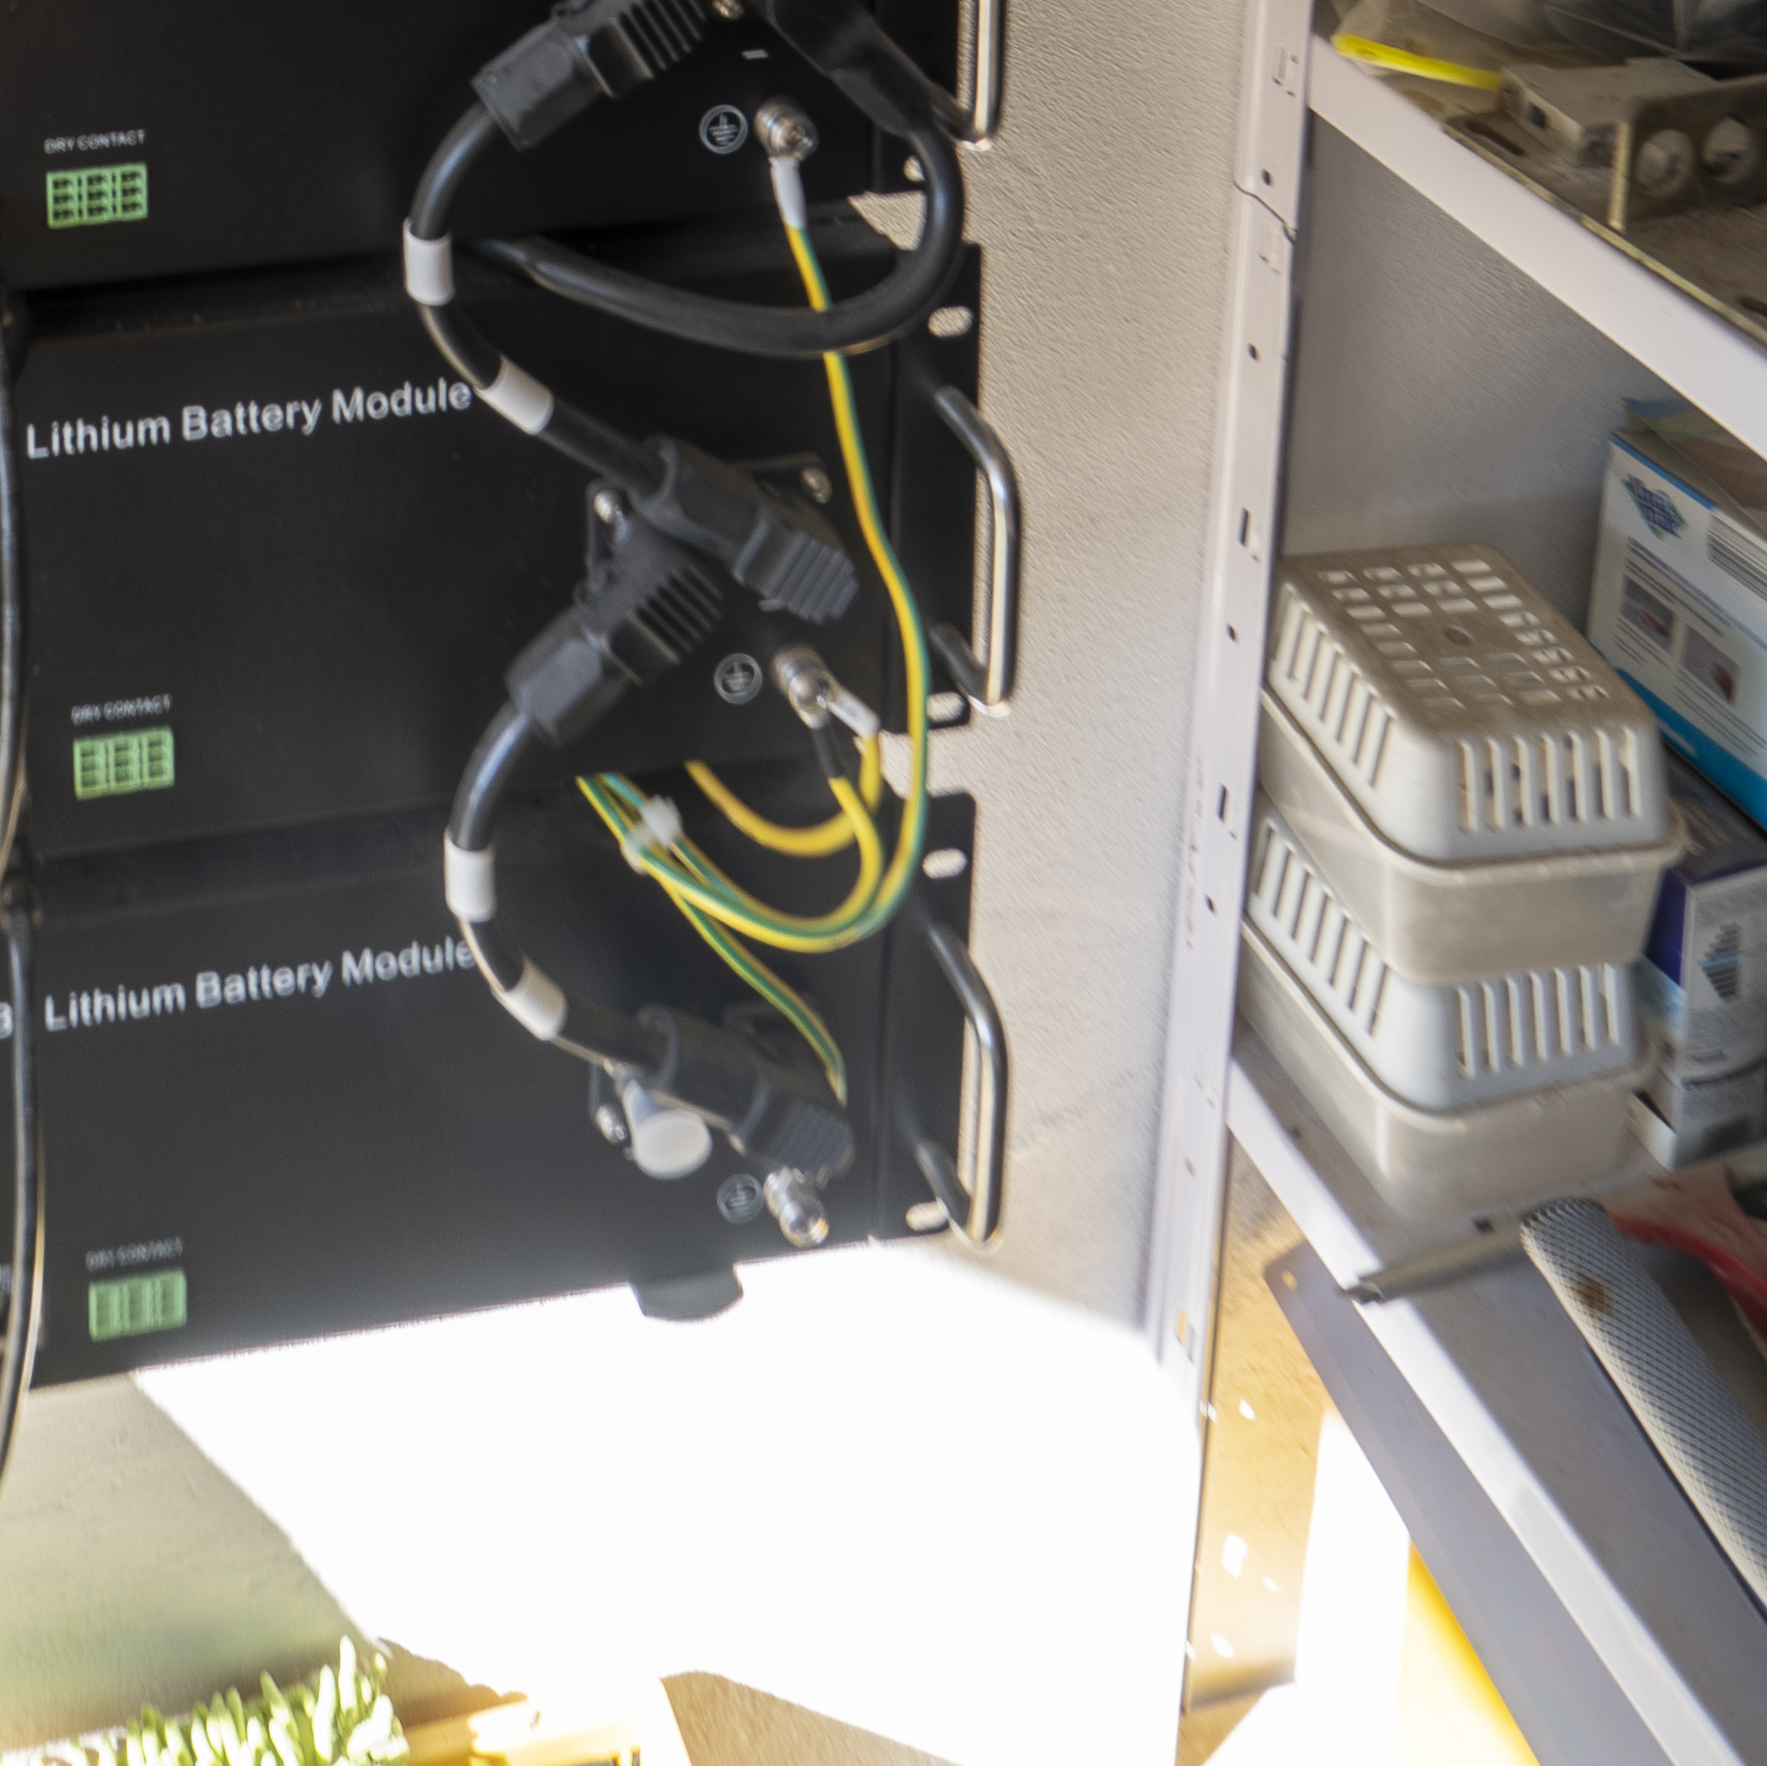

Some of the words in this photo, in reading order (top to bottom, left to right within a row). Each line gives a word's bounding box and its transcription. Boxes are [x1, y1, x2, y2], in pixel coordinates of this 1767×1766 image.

[76, 128, 146, 151] CONTACT
[26, 415, 171, 459] Lithium
[181, 399, 322, 441] Battery
[332, 377, 473, 424] Module
[44, 982, 187, 1033] Lithium
[195, 959, 334, 1010] Battery
[341, 934, 476, 988] Module
